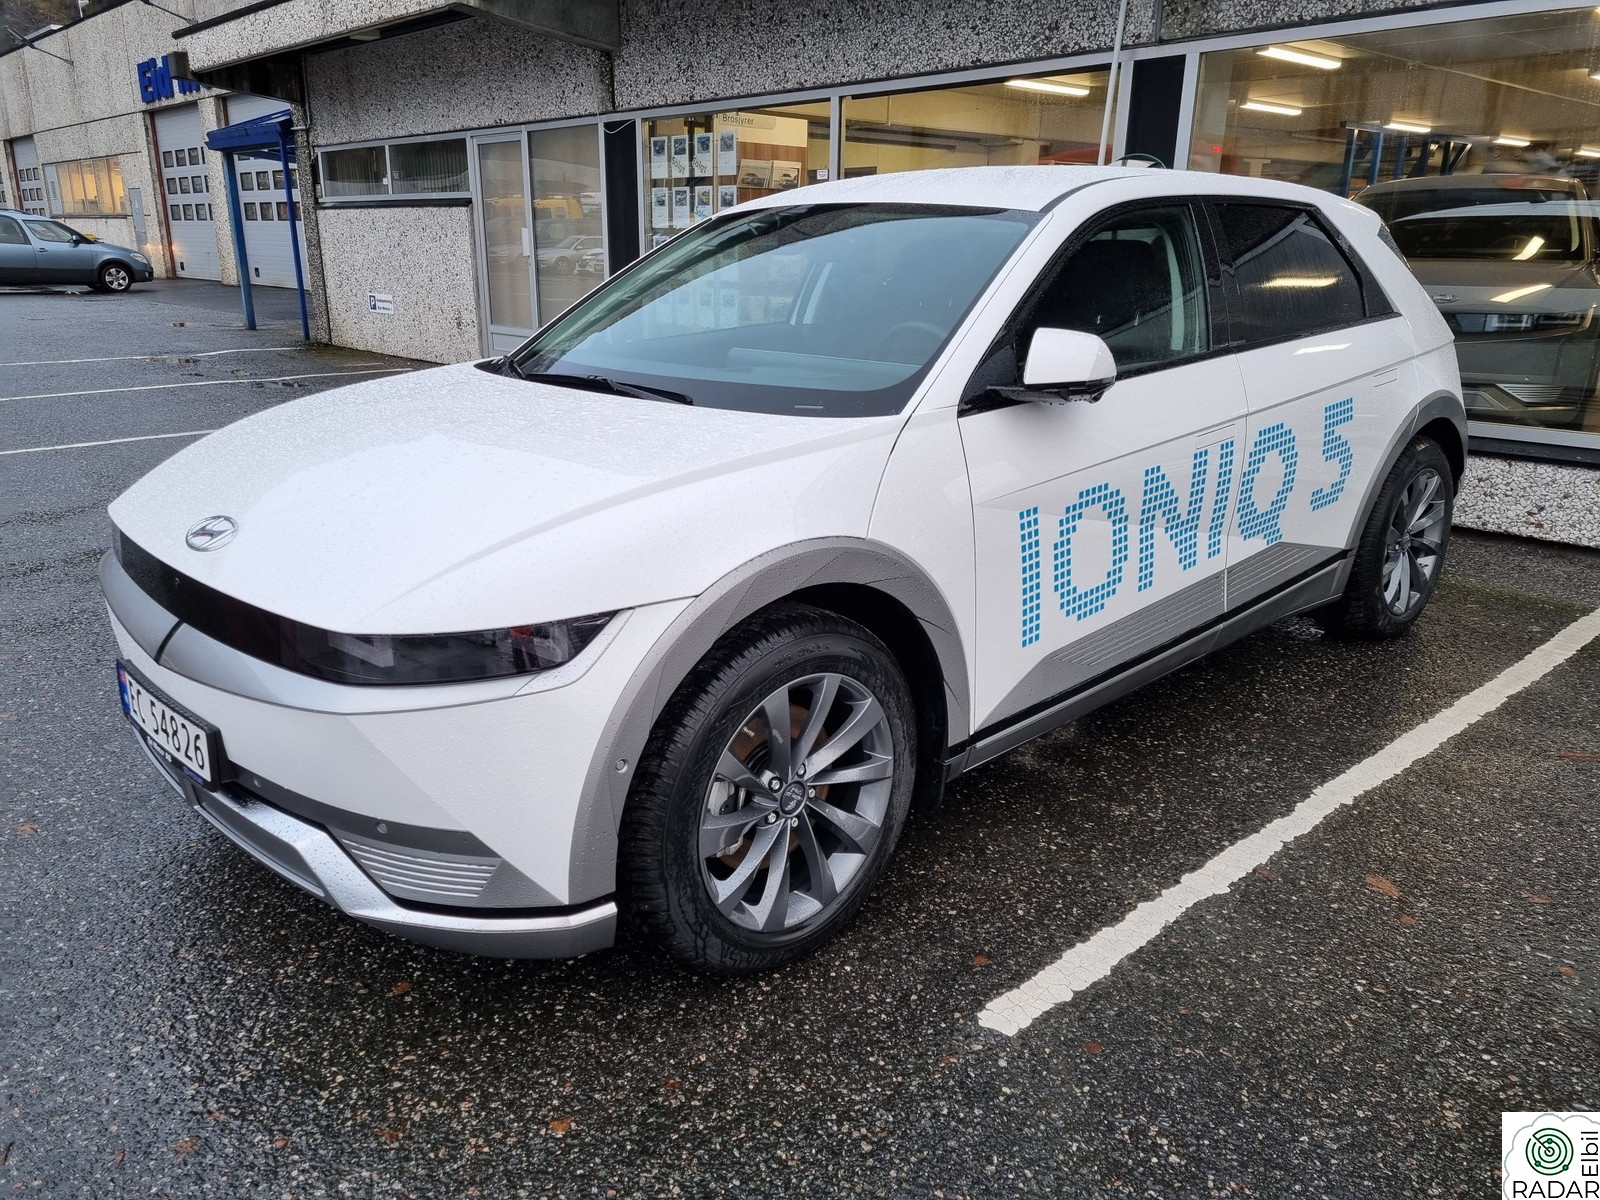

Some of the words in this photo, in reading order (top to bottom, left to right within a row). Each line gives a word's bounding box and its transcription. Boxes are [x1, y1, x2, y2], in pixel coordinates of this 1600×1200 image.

[137, 54, 174, 104] Eid
[722, 113, 754, 125] Brosjyrer
[1019, 422, 1298, 648] IONIQ
[1310, 397, 1353, 512] 5
[129, 679, 146, 724] EC
[150, 699, 205, 770] 54826
